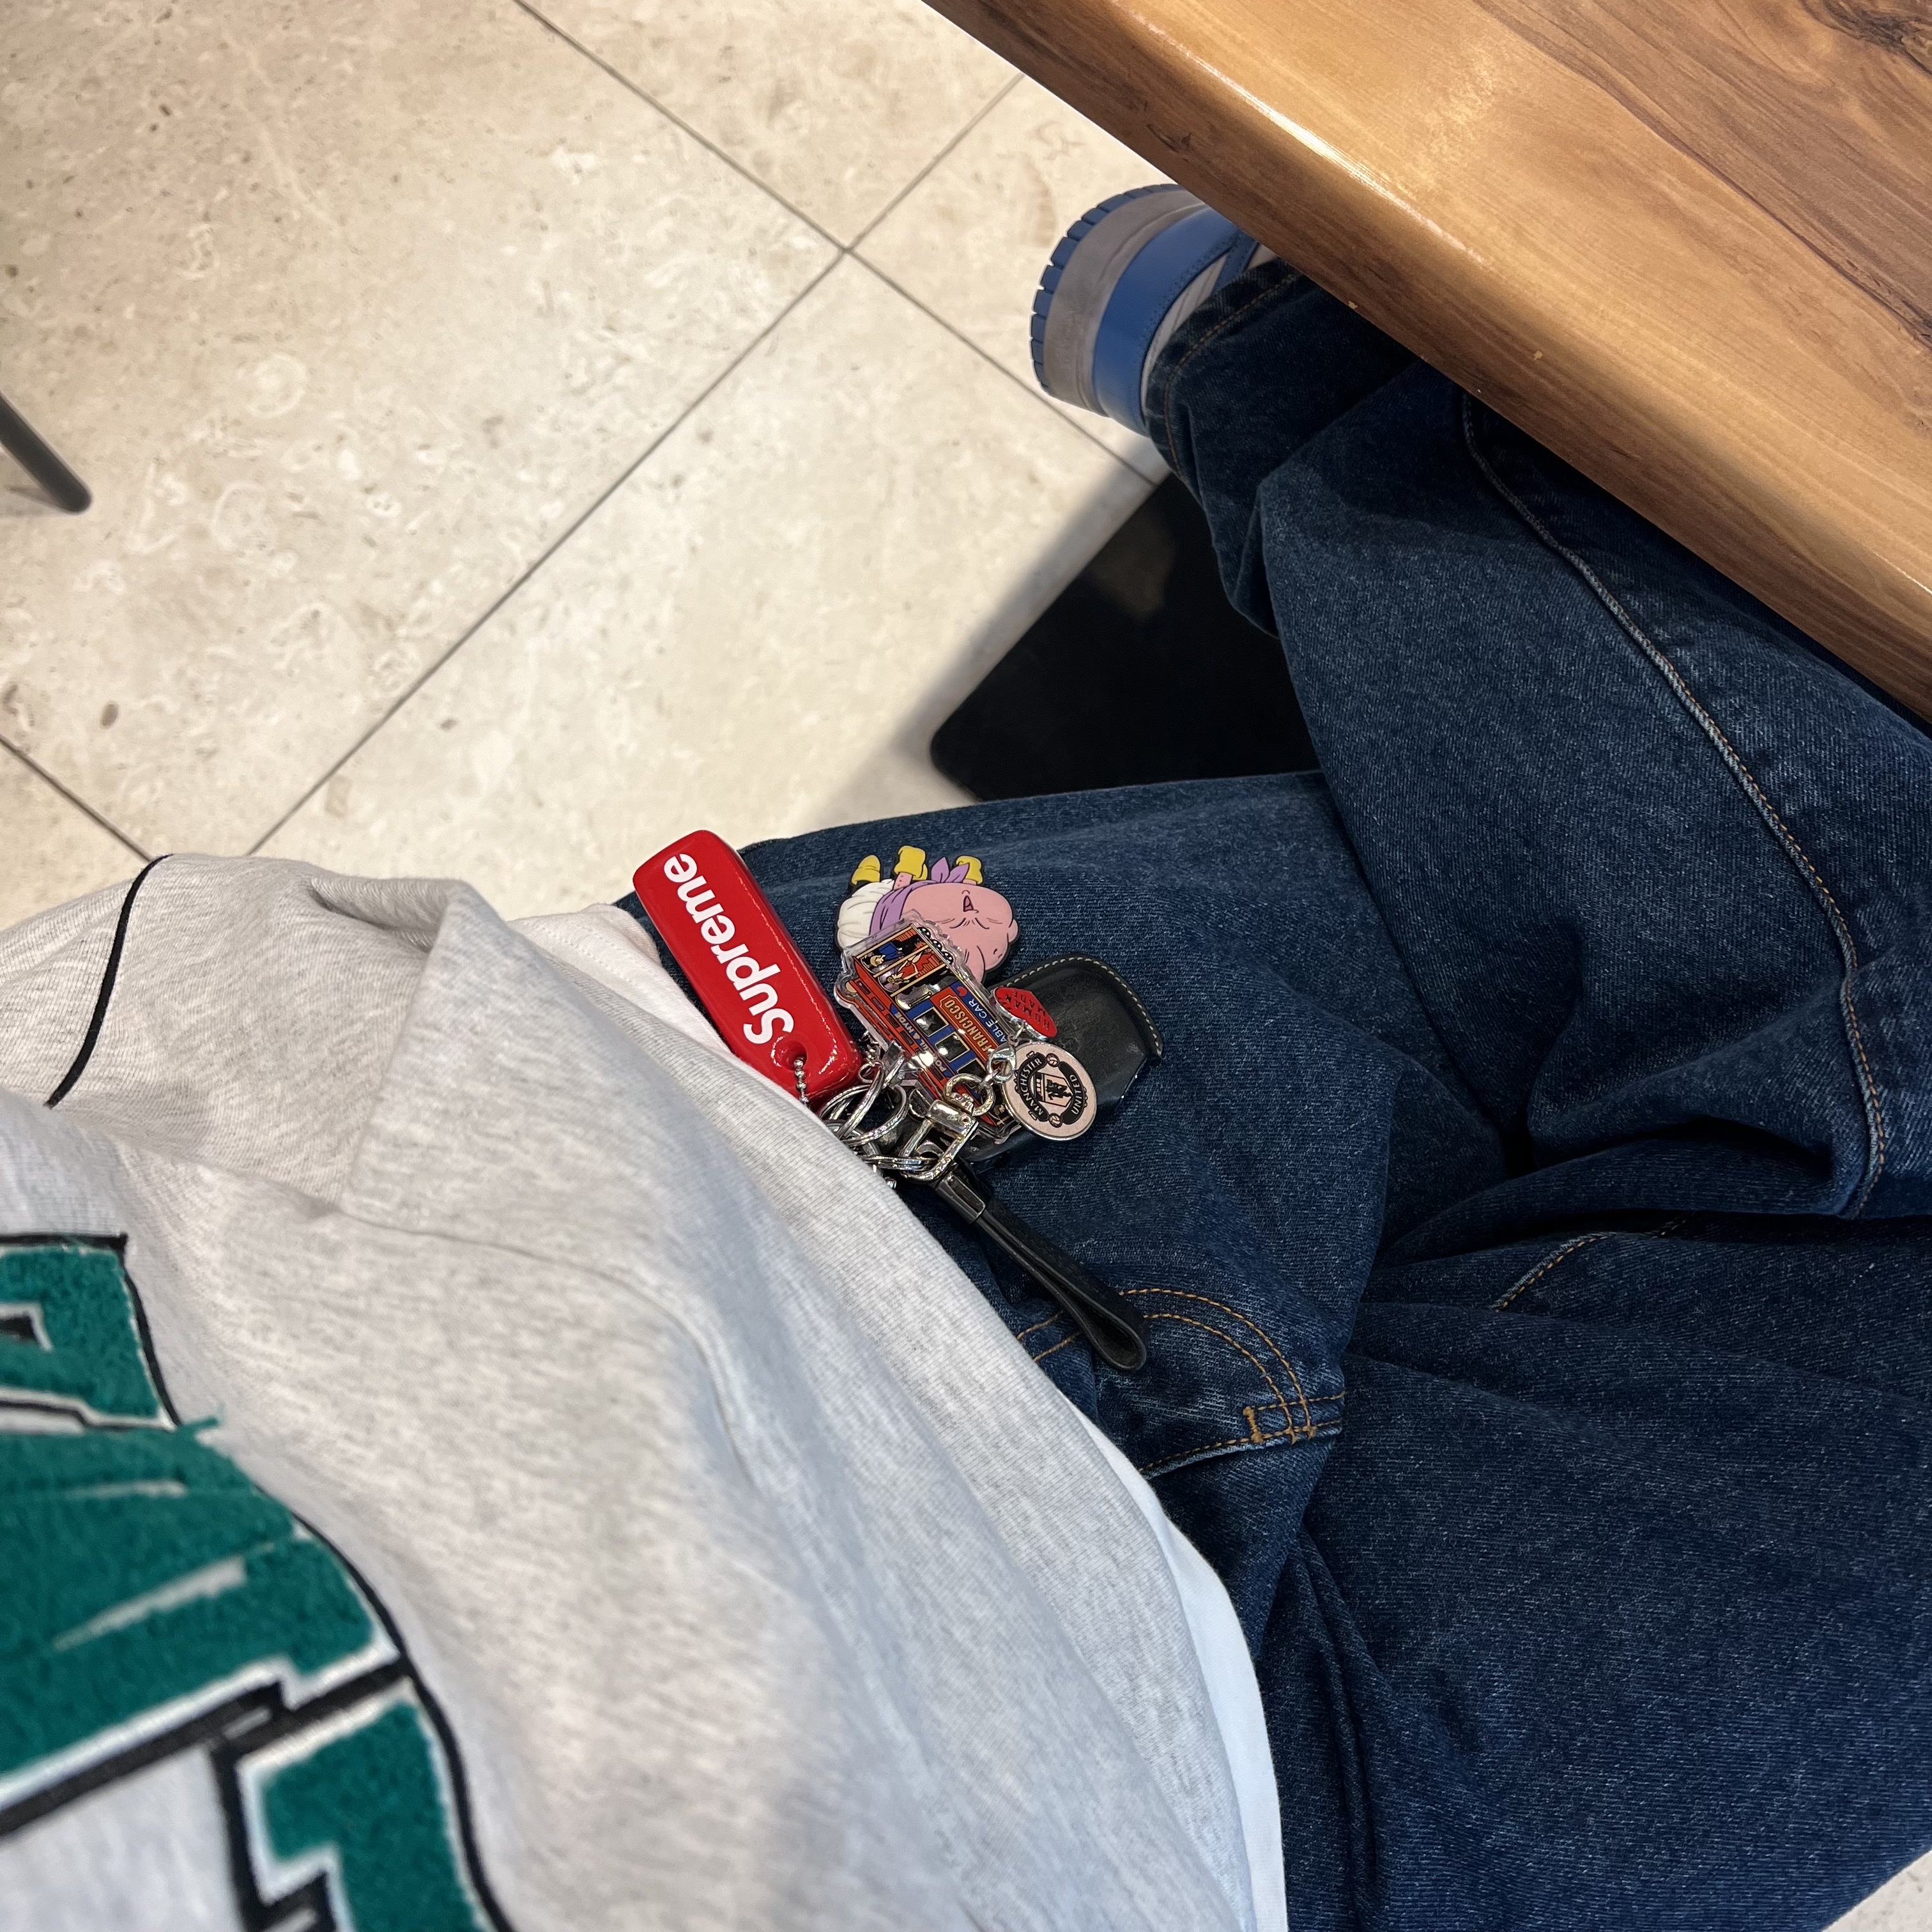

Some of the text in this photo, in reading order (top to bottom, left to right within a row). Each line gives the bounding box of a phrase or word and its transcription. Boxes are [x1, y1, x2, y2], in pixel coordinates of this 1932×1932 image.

[664, 853, 794, 1045] Supreme
[894, 1011, 915, 1033] HYDE
[968, 998, 1008, 1042] ABLE CAR
[1006, 994, 1050, 1030] HUMAN
[1012, 990, 1046, 1018] MADE
[944, 999, 993, 1052] FRANCISCO
[1018, 1057, 1043, 1116] MANCHESTER
[1070, 1074, 1082, 1115] UNITED
